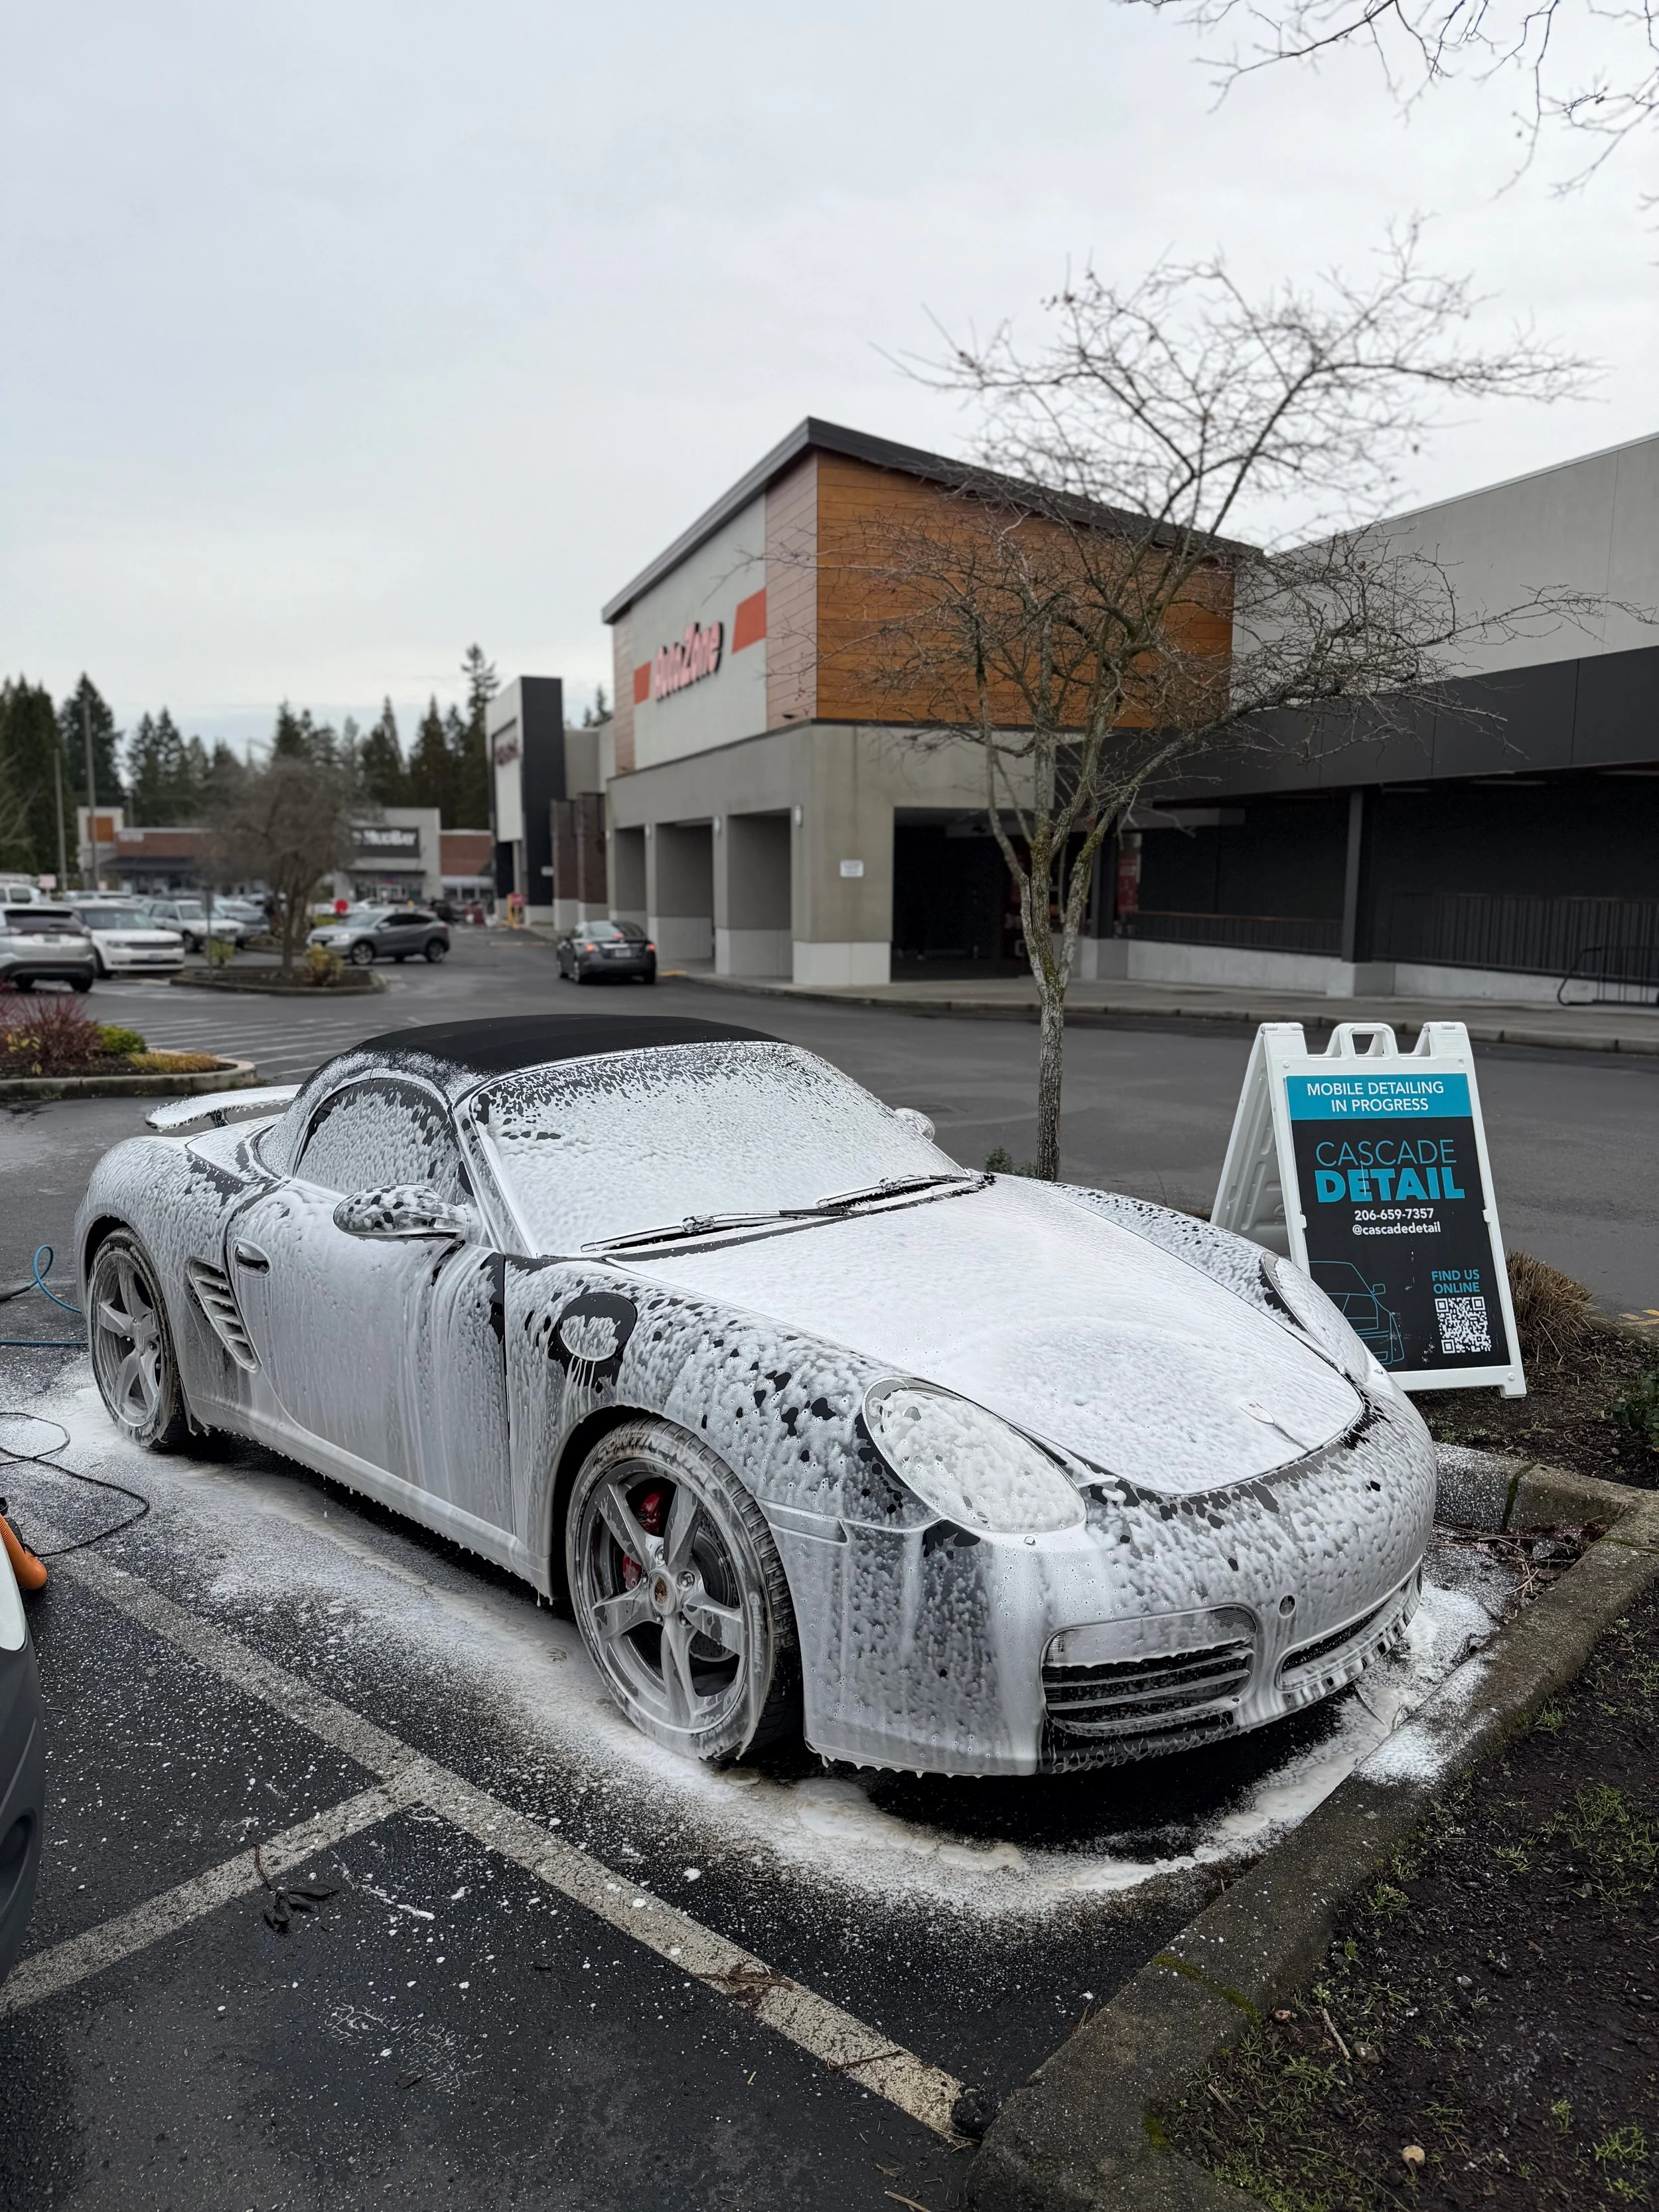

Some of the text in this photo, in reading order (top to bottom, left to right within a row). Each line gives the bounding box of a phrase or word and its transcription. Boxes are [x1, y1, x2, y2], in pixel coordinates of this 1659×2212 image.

[1307, 1081, 1444, 1096] MOBILE DETAILING
[1331, 1098, 1429, 1112] IN PROGRESS
[1315, 1139, 1457, 1167] CASCADE
[1315, 1167, 1465, 1203] DETAIL
[1354, 1208, 1434, 1221] 206-659-7357
[1352, 1221, 1441, 1236] @cascadedetail
[1431, 1269, 1480, 1282] FIND US
[1433, 1282, 1480, 1294] ONLINE
